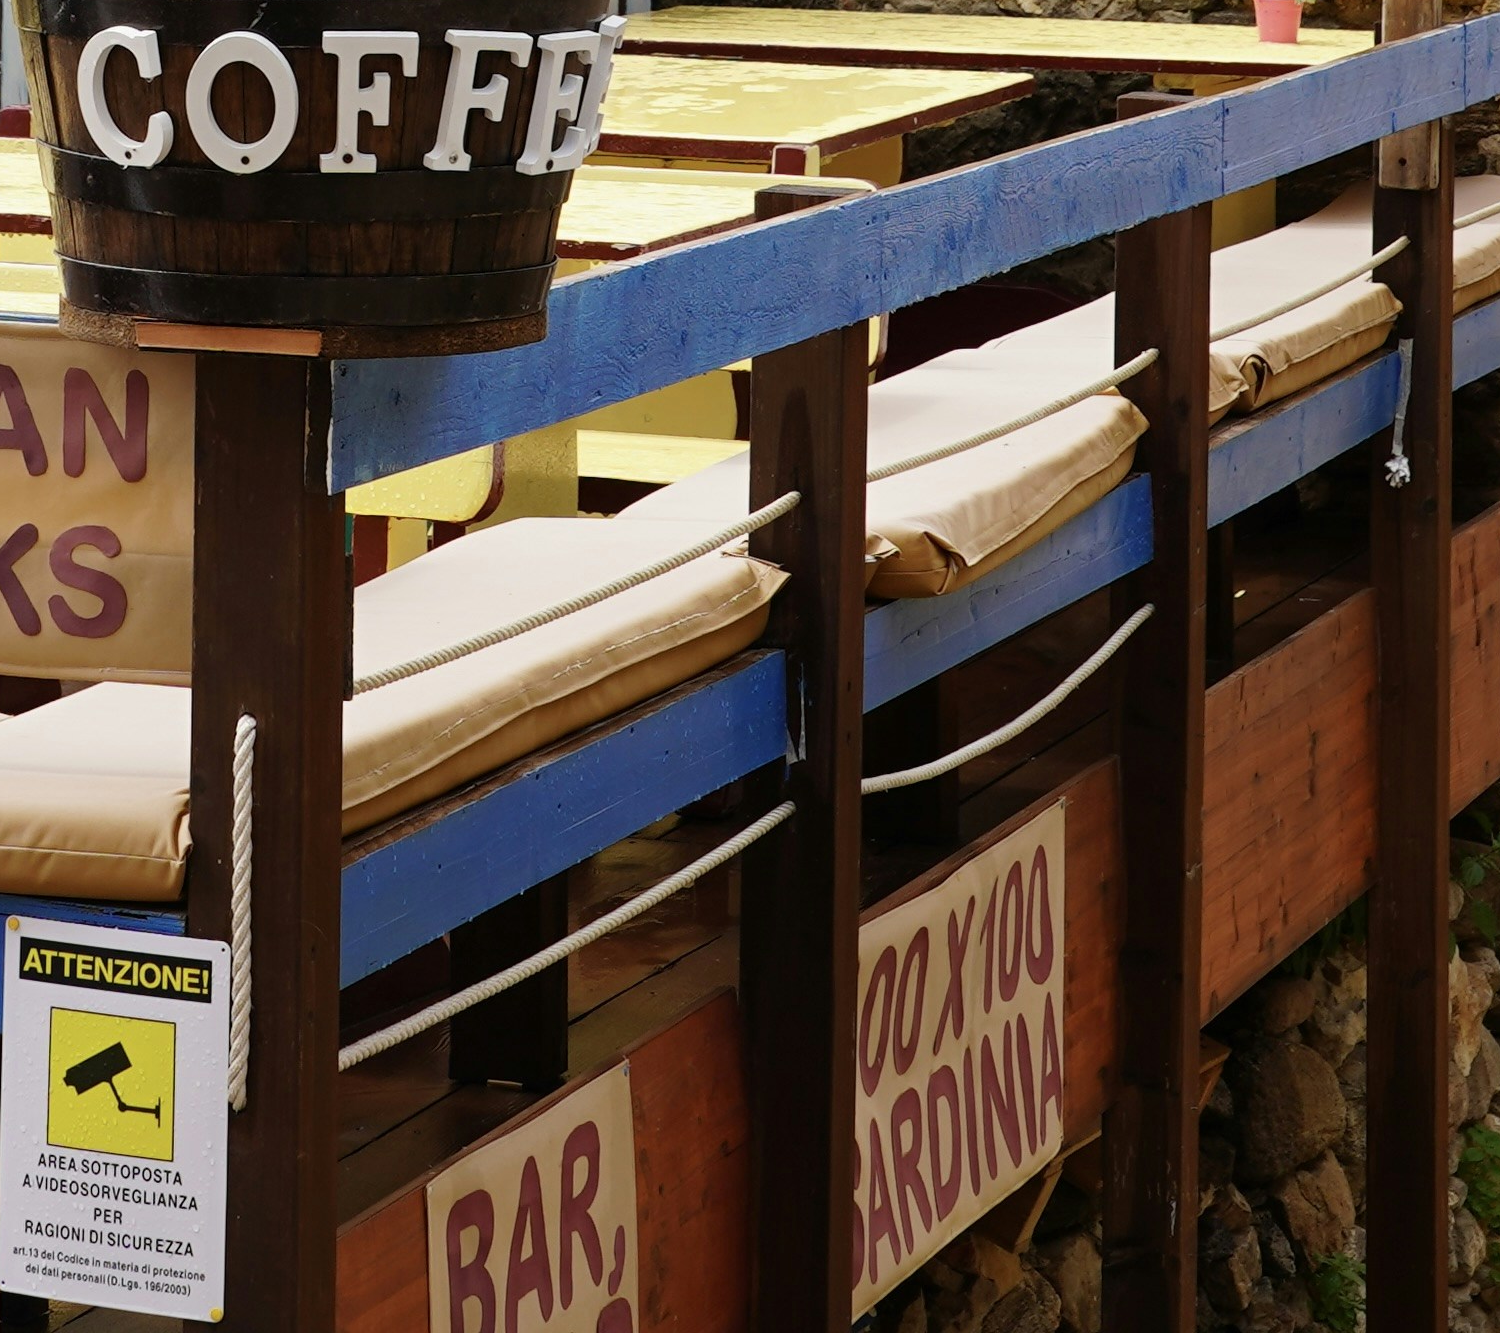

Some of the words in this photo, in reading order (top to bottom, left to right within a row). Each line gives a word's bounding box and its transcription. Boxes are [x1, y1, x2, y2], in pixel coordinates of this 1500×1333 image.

[22, 946, 210, 996] ATTENZIONE!
[37, 1152, 78, 1173] AREA
[80, 1158, 184, 1186] SOTTOPOSTA
[22, 1173, 32, 1188] A
[35, 1175, 199, 1212] VIDEOSORVEGLIANZA
[93, 1207, 124, 1225] PER
[24, 1219, 86, 1243] RAGIONI
[89, 1229, 103, 1245] DI
[106, 1232, 195, 1258] SICUREZZA
[41, 1267, 60, 1278] dati
[61, 1270, 106, 1286] personali
[145, 1281, 192, 1298] 196/2003)
[56, 1251, 90, 1267] Codice
[91, 1256, 101, 1268] in
[103, 1260, 139, 1274] materia
[141, 1263, 151, 1275] di
[152, 1266, 206, 1283] protezione
